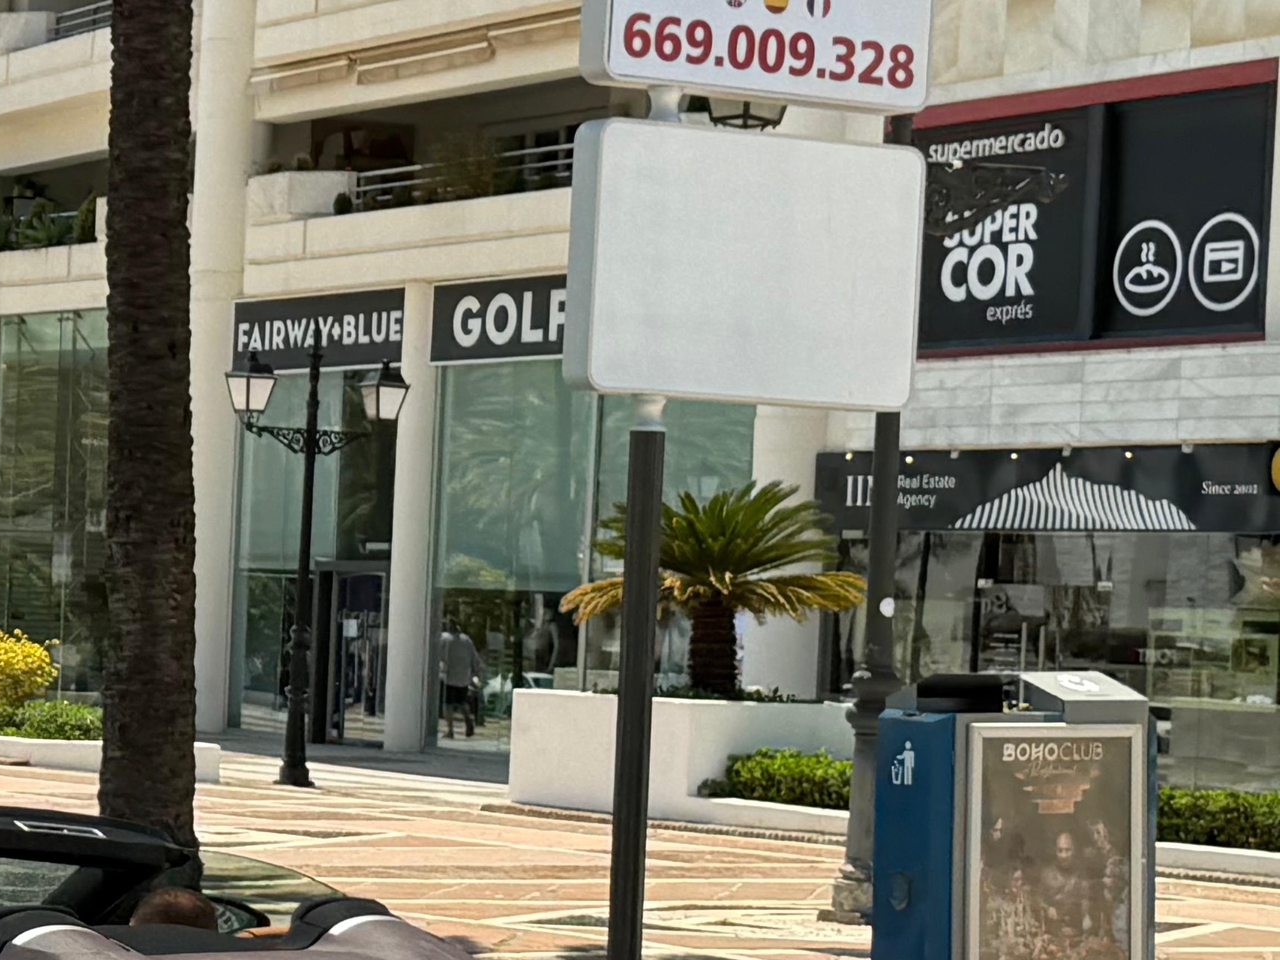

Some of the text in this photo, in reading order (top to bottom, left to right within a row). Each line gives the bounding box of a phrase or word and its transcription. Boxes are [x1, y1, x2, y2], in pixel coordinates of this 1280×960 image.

[623, 12, 915, 89] 669.009.328
[927, 123, 1066, 163] supermercado
[941, 242, 1035, 302] COR
[986, 299, 1033, 325] exprés
[897, 474, 956, 489] Real Estate
[1201, 480, 1231, 495] Since
[897, 491, 937, 509] Agency
